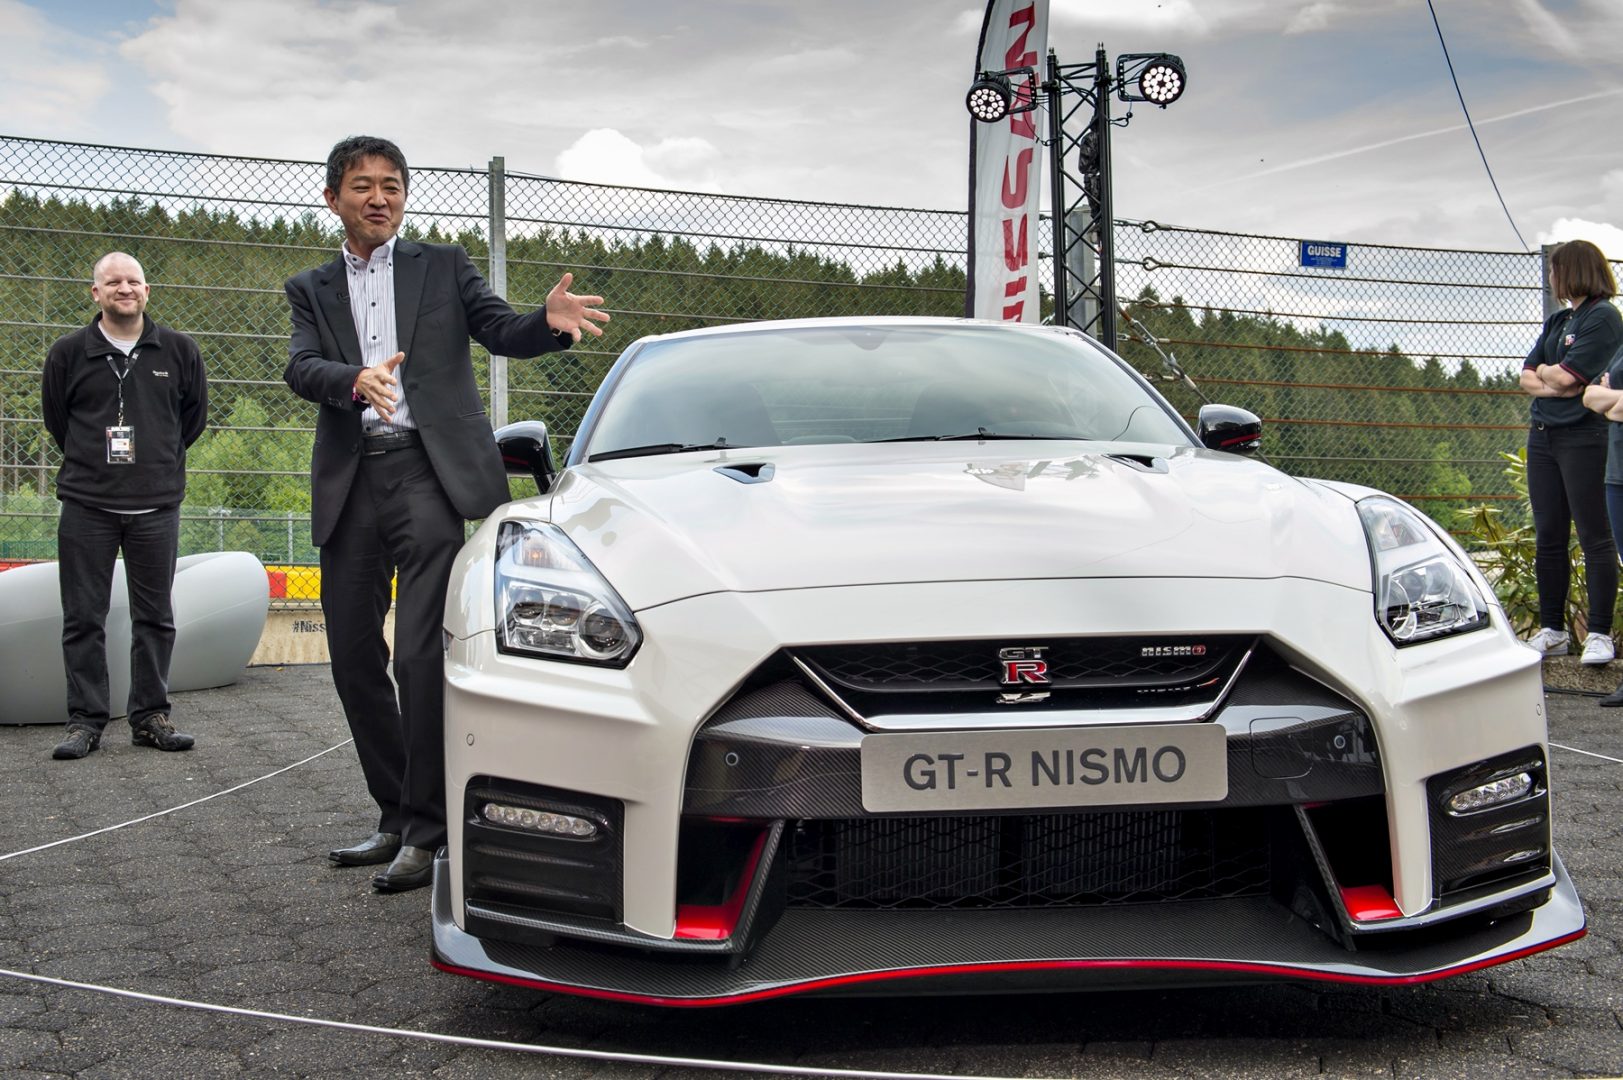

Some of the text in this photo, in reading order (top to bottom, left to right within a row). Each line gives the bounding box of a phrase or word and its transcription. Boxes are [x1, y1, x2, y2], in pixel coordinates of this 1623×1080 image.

[1307, 245, 1342, 258] GUISSE
[292, 620, 326, 633] #Niss
[903, 745, 1186, 790] GT-R NISMO
